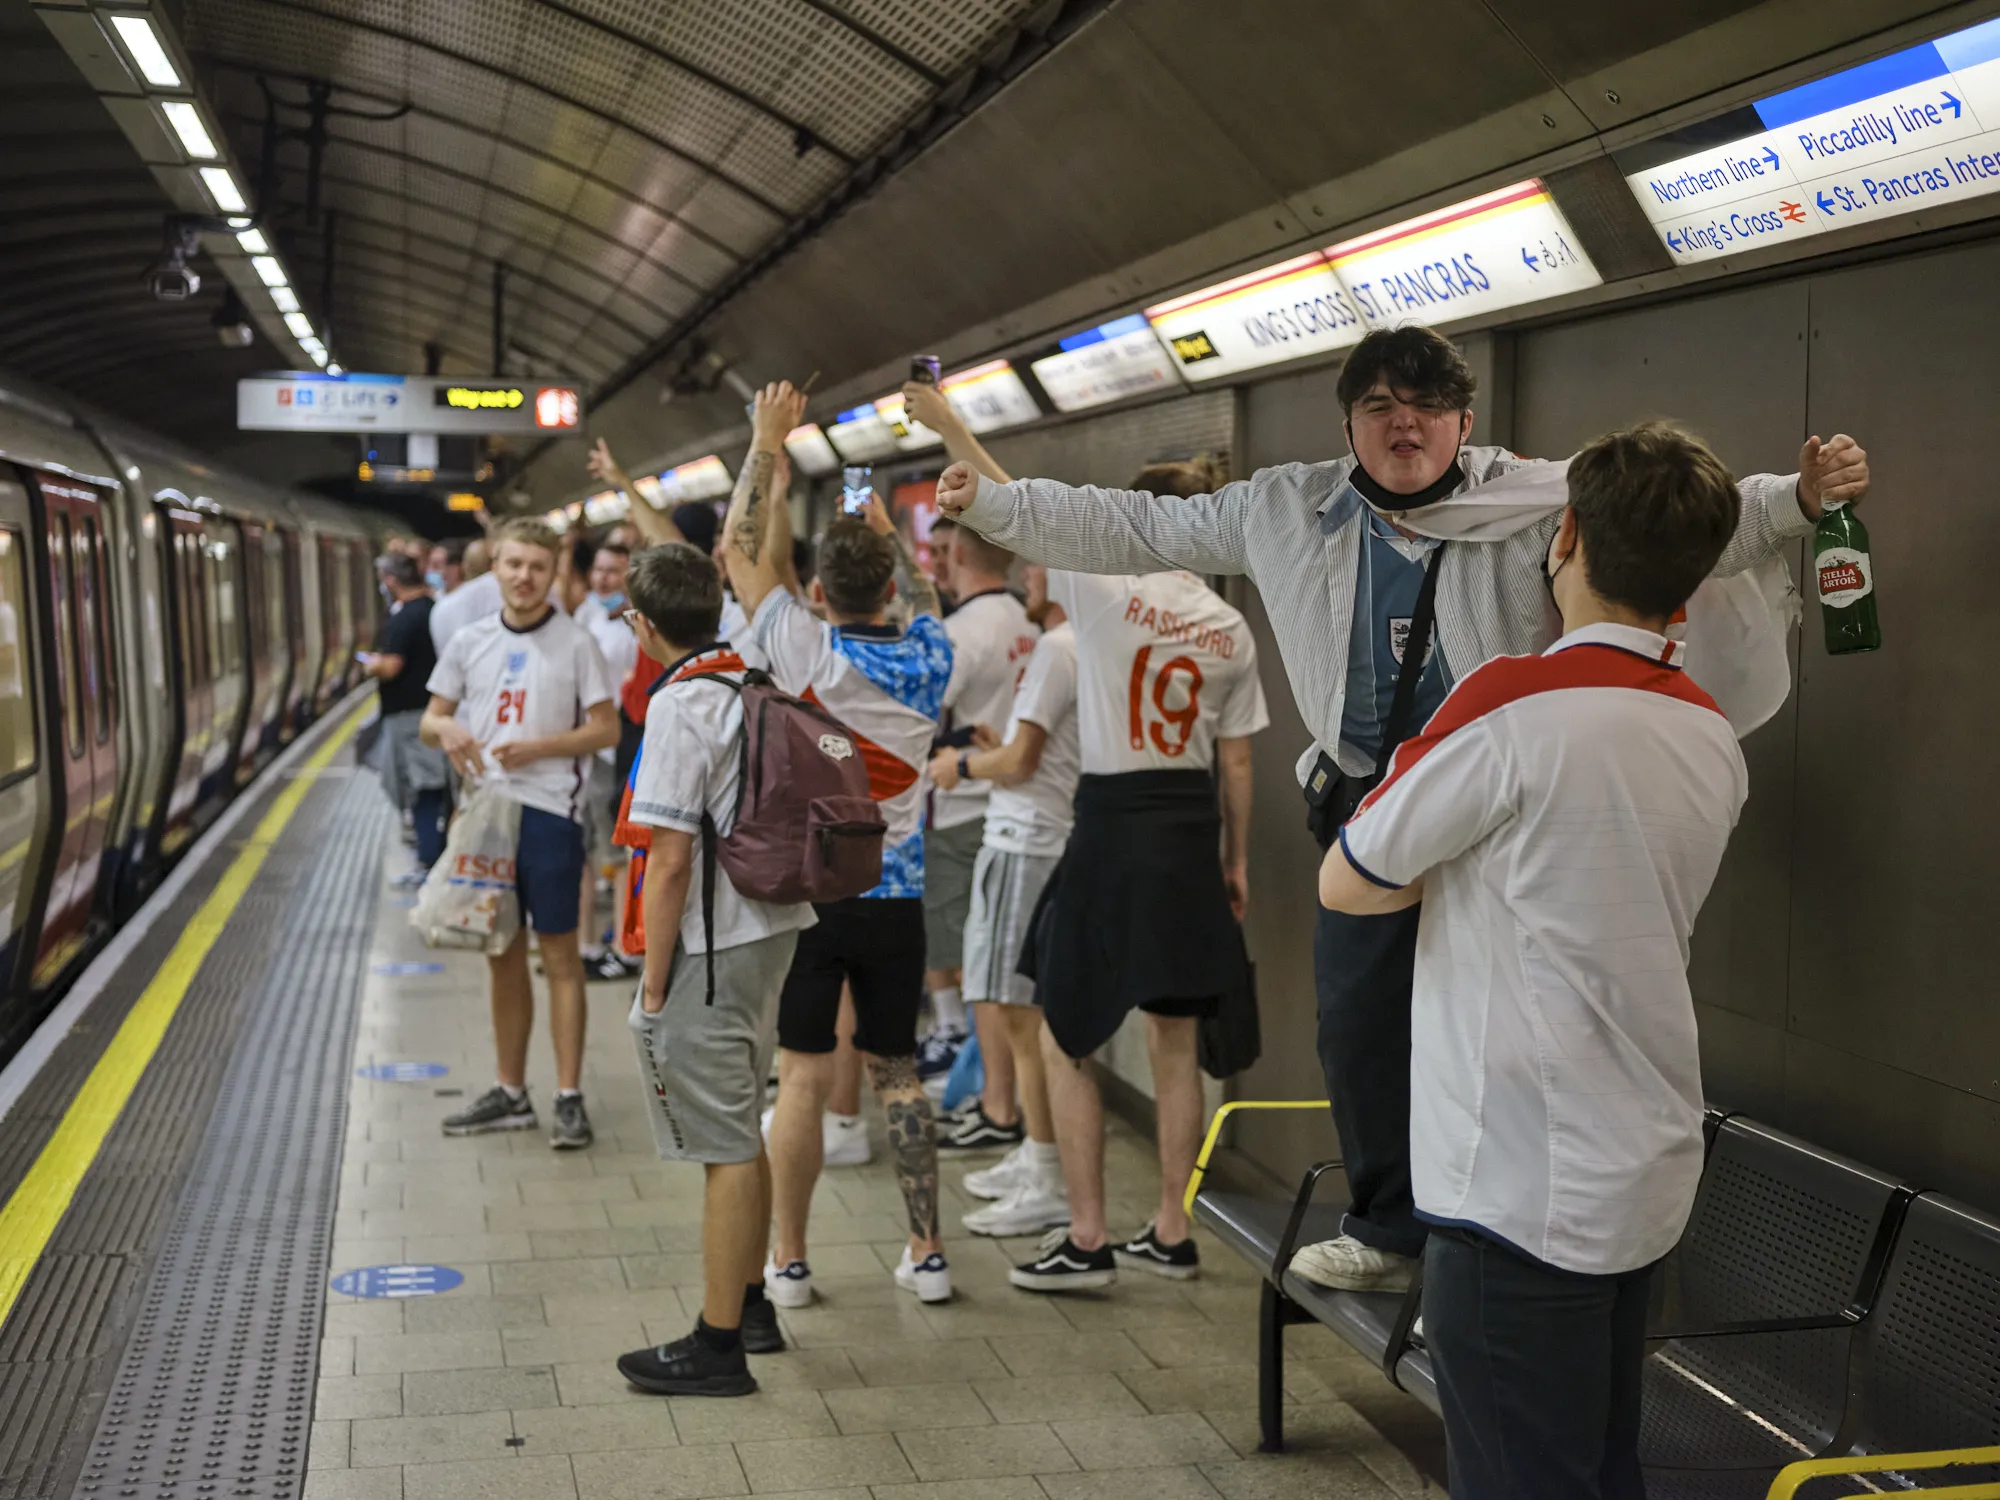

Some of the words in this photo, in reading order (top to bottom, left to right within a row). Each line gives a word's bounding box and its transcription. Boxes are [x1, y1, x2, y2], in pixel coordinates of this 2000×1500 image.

[1798, 115, 1898, 161] Piccadilly
[1898, 102, 1943, 133] line
[1650, 168, 1731, 204] Northern
[1725, 156, 1765, 184] line
[1833, 185, 1867, 212] St.
[1862, 167, 1950, 206] Pancras
[1680, 221, 1734, 251] King's
[1730, 208, 1784, 238] Cross
[1242, 307, 1300, 345] KINGS
[1294, 291, 1357, 334] CROSS
[1352, 282, 1391, 320] ST.
[1381, 253, 1490, 312] PANCRAS
[1822, 569, 1856, 581] STELLA
[1823, 577, 1857, 588] ARTOIS
[496, 688, 527, 725] 24
[1128, 645, 1204, 757] 19
[452, 854, 516, 881] ESC
